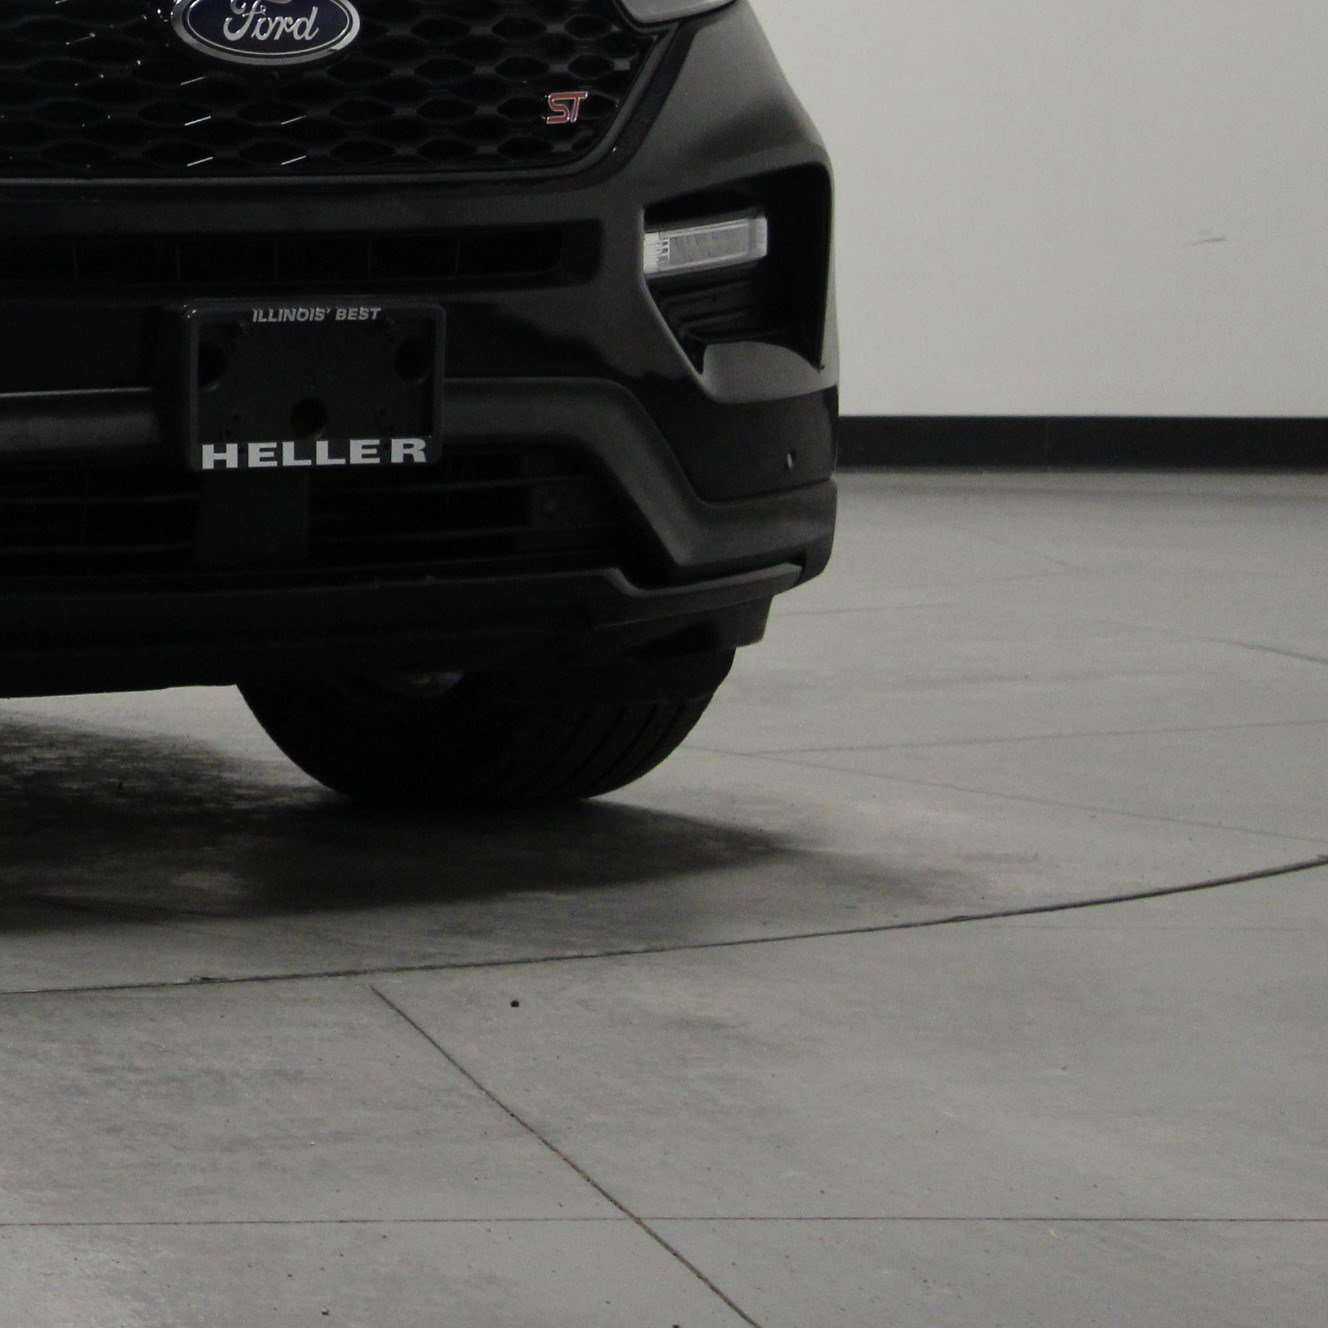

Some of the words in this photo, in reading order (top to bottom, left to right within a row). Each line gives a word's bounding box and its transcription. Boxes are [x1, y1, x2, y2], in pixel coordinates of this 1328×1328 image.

[546, 92, 588, 124] ST
[335, 306, 382, 322] BEST
[201, 438, 427, 470] HELLER
